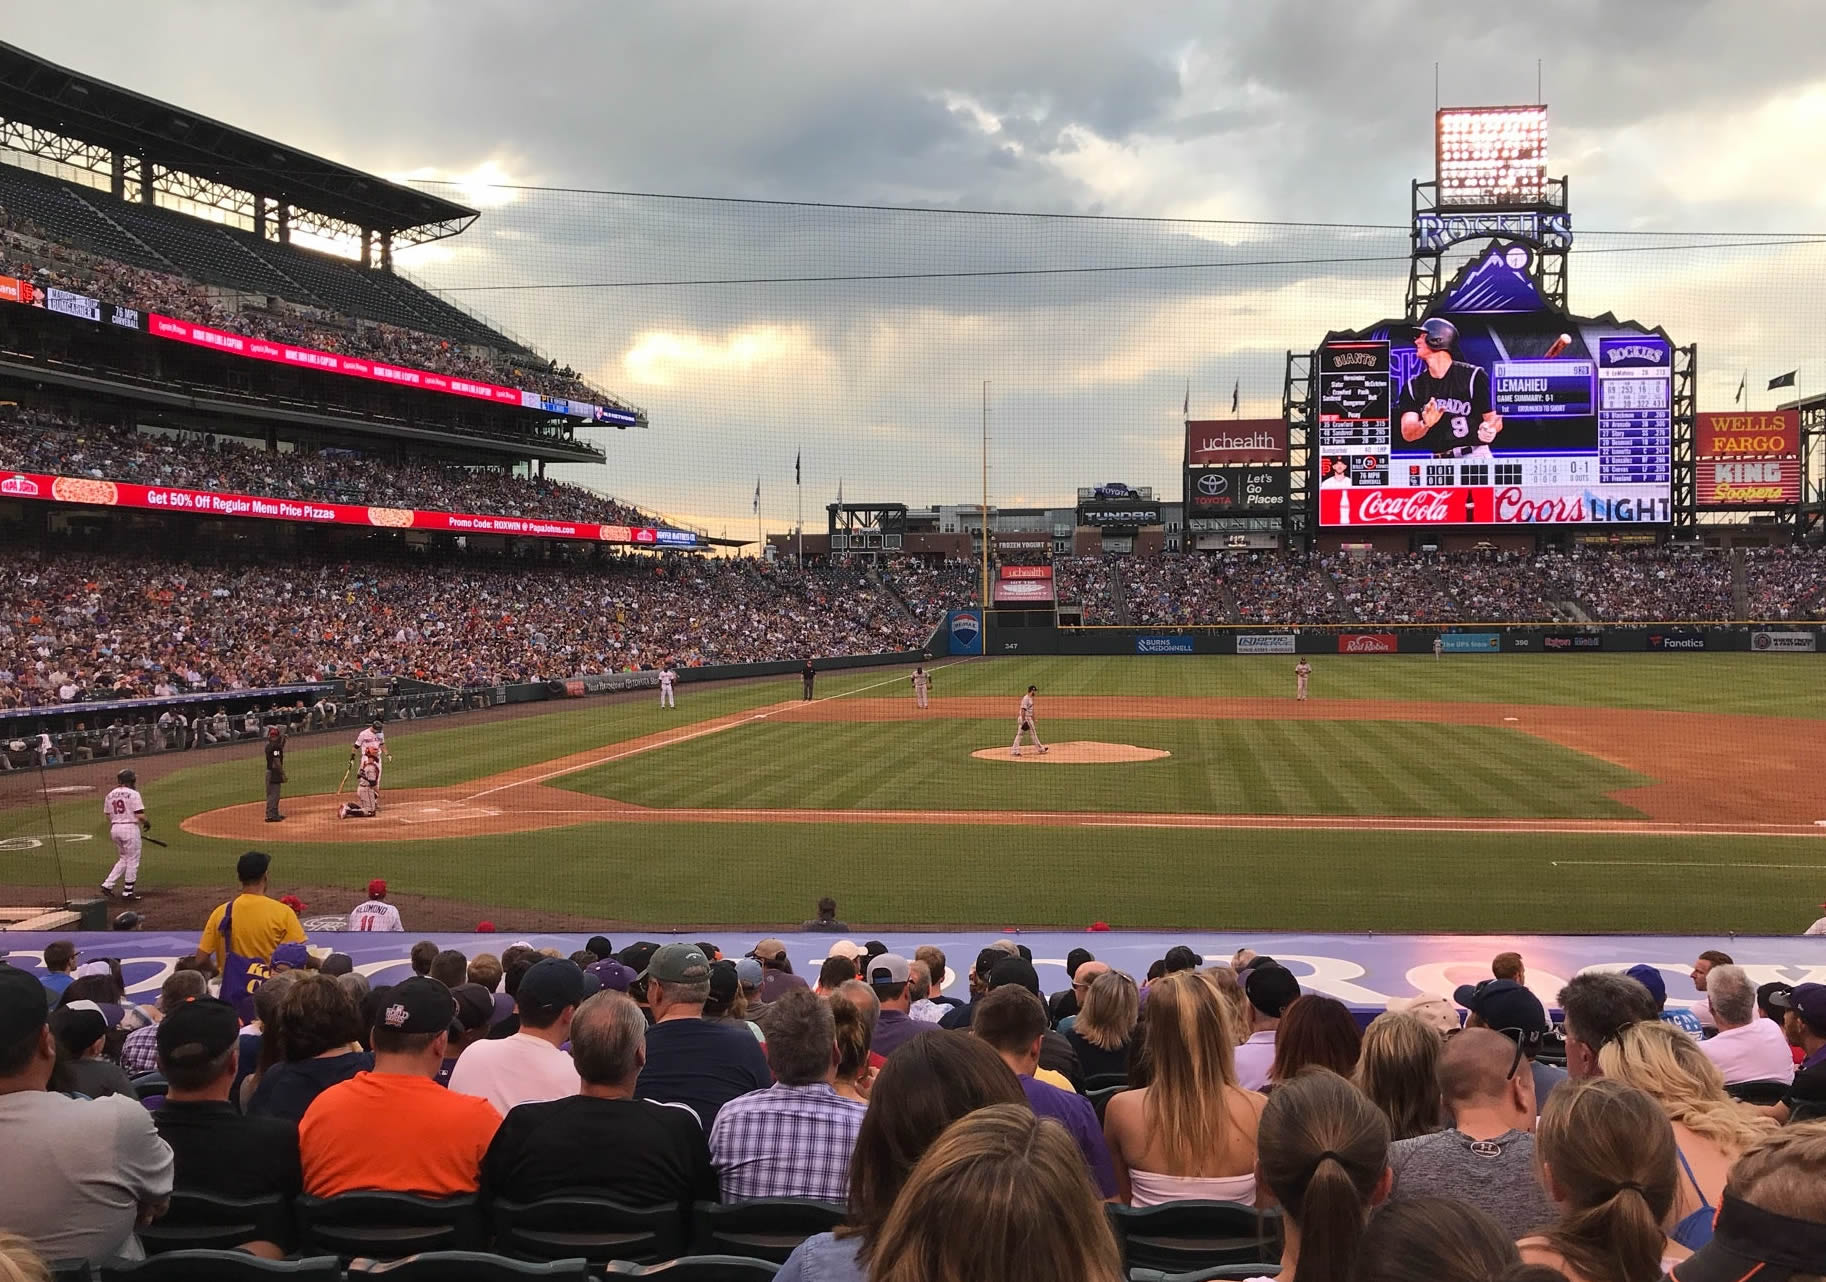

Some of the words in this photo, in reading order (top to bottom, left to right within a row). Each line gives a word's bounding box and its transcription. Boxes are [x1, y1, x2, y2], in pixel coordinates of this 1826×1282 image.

[1333, 353, 1376, 367] GIANTS
[1607, 345, 1663, 363] ROCKIES
[1497, 379, 1548, 392] LEMAHIEU
[1497, 395, 1513, 403] GAME
[1514, 394, 1544, 403] SUMMARY:
[1451, 417, 1469, 438] 9
[1710, 416, 1785, 431] WELLS
[1203, 431, 1274, 450] uchealth
[1712, 436, 1785, 451] FARGO
[1247, 474, 1272, 483] Let's
[1714, 463, 1781, 483] KING
[1101, 488, 1129, 496] TOYOTA
[1246, 485, 1262, 493] Go
[1712, 482, 1783, 502] Soopers
[148, 490, 167, 505] Get
[170, 493, 192, 507] 50%
[195, 495, 210, 508] Off
[213, 497, 250, 513] Regular
[252, 501, 278, 515] Menu
[280, 503, 302, 517] Price
[304, 506, 335, 520] Pizzas
[1247, 494, 1283, 504] Places
[1359, 490, 1454, 521] Coca-Cola
[1495, 486, 1585, 522] Coors
[1591, 498, 1669, 521] LIGHT
[1085, 511, 1156, 520] TUNDRA
[449, 517, 472, 528] Promo
[473, 518, 492, 529] Code:
[494, 520, 520, 530] ROXWIN
[521, 522, 528, 531] @
[529, 522, 575, 534] PapaJohns.com
[1009, 567, 1044, 577] uchealth
[1347, 640, 1364, 651] Red
[1364, 640, 1389, 651] Robin
[1664, 638, 1704, 647] Fanatics
[112, 799, 125, 814] 19
[361, 916, 375, 931] 11
